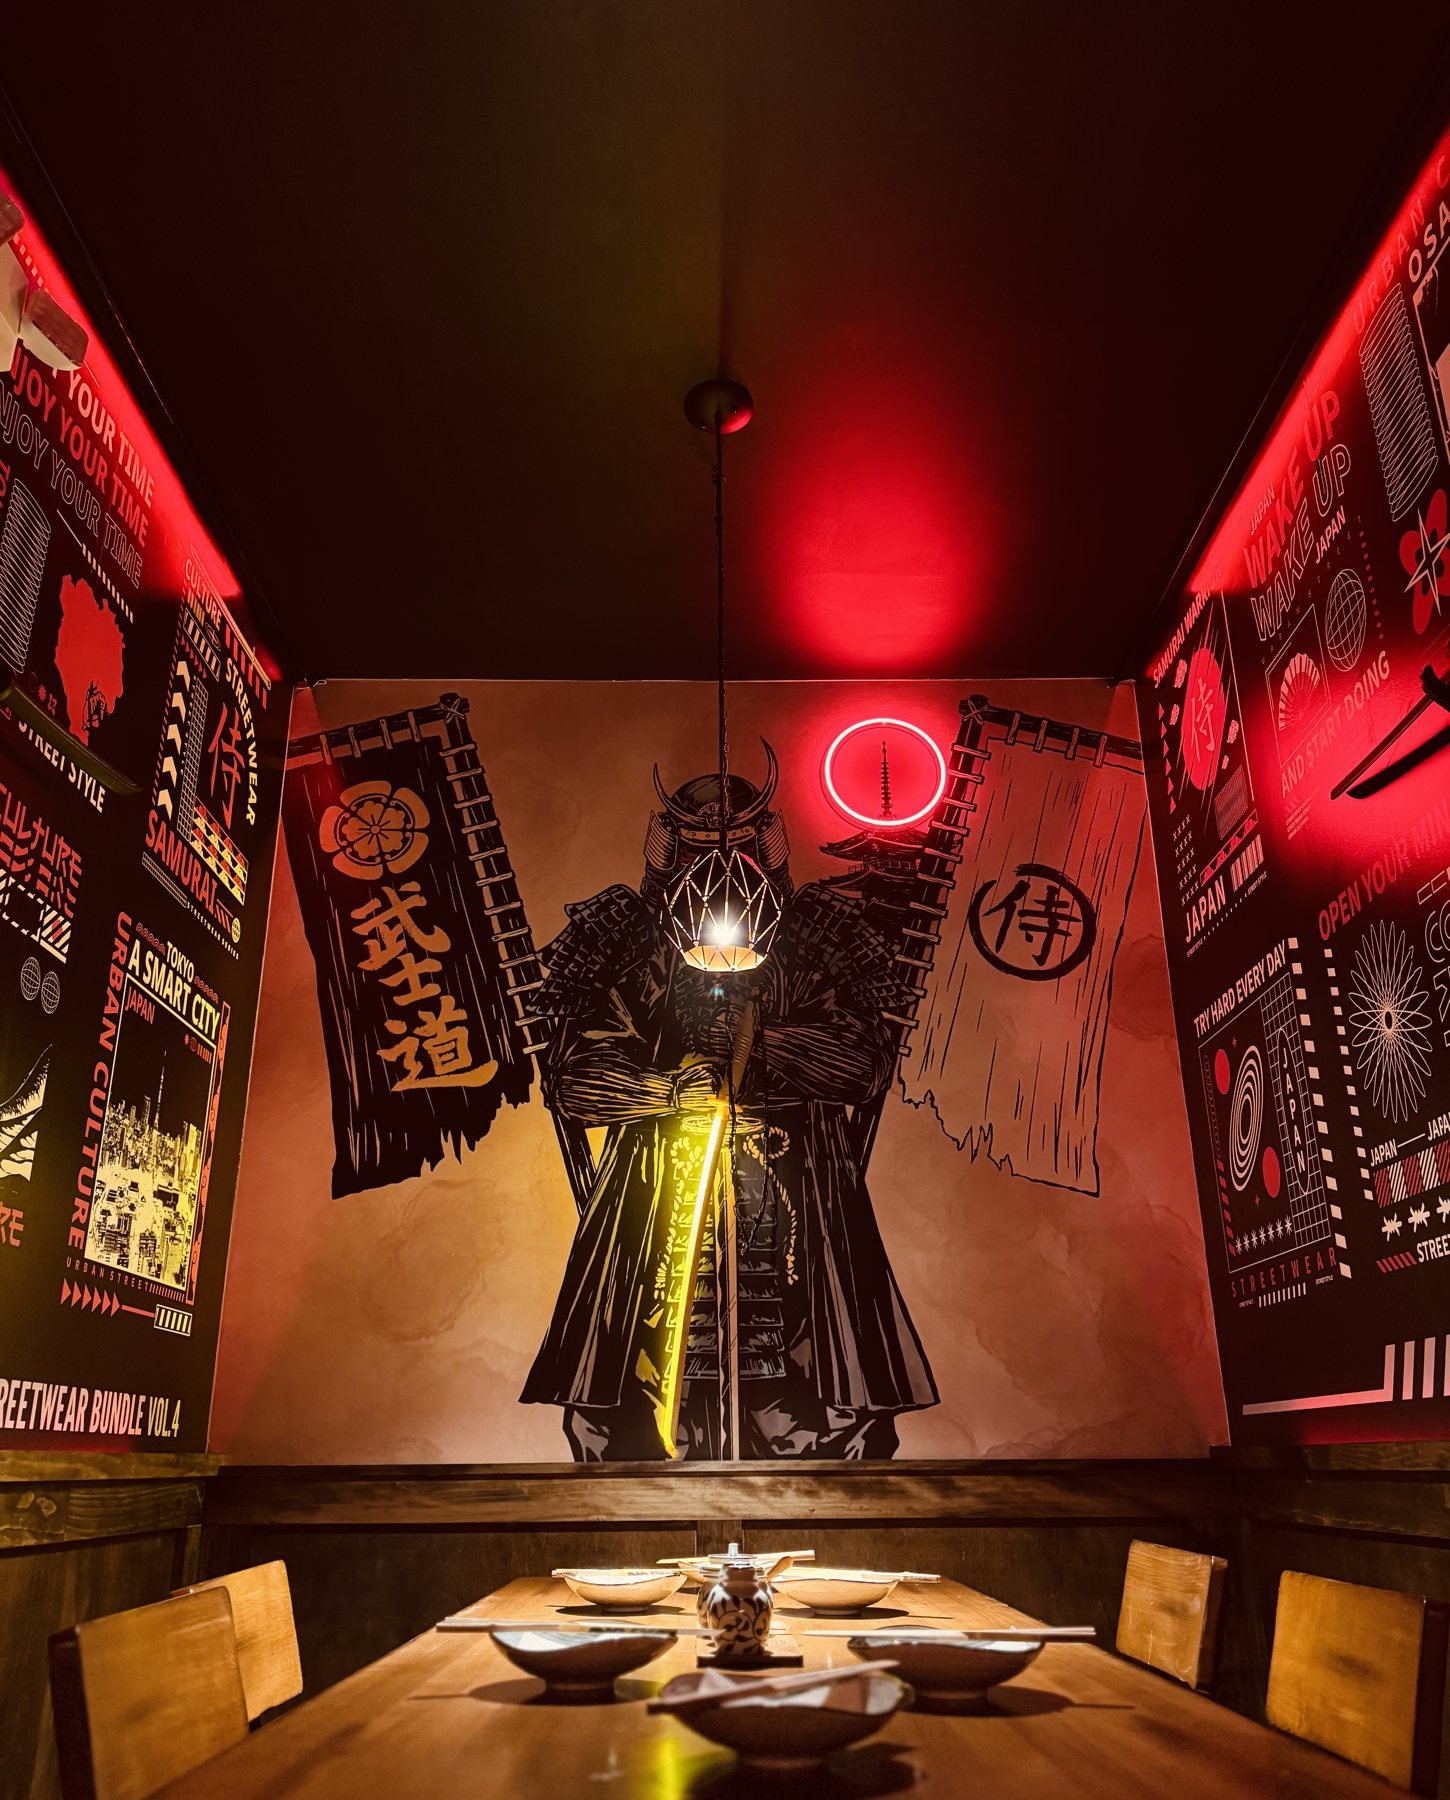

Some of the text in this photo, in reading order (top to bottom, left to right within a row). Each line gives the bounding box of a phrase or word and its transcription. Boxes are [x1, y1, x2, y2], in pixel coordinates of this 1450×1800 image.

[60, 406, 108, 494] YOUR
[110, 472, 148, 547] TIME
[68, 369, 155, 508] YOUR TIME
[50, 449, 101, 537] YOUR
[103, 513, 143, 589] TIME
[1243, 446, 1304, 589] WAKE
[1303, 390, 1340, 462] UP
[1250, 482, 1275, 536] JAPAN
[1316, 505, 1346, 564] JAPAN
[1250, 497, 1315, 642] WAKE
[1312, 443, 1351, 518] UP
[185, 559, 222, 631] CULTURE
[1153, 623, 1185, 689] SAMURAI
[208, 702, 245, 830] 侍
[226, 658, 258, 826] STREETWEAR
[1282, 761, 1306, 799] AND
[1305, 704, 1342, 770] START
[1343, 650, 1390, 722] DOING
[145, 809, 218, 915] SAMURAI
[1185, 875, 1226, 943] JAPAN
[1318, 881, 1361, 941] OPEN
[1361, 837, 1412, 903] YOUR
[166, 941, 195, 983] TOKYO
[982, 880, 1082, 966] 侍
[125, 986, 156, 1025] JAPAN
[128, 939, 220, 1040] A SMART CITY
[350, 881, 498, 1092] 武士道
[1193, 939, 1286, 1039] TRY HARD EVERY DAY
[67, 911, 133, 1250] URBAN CULTURE
[1282, 1046, 1306, 1174] JAPAN
[1370, 1139, 1398, 1167] JAPAN
[66, 1256, 149, 1292] URBAN STREET
[1231, 1247, 1337, 1298] STREETWEAR
[89, 1389, 147, 1436] BUNDLE
